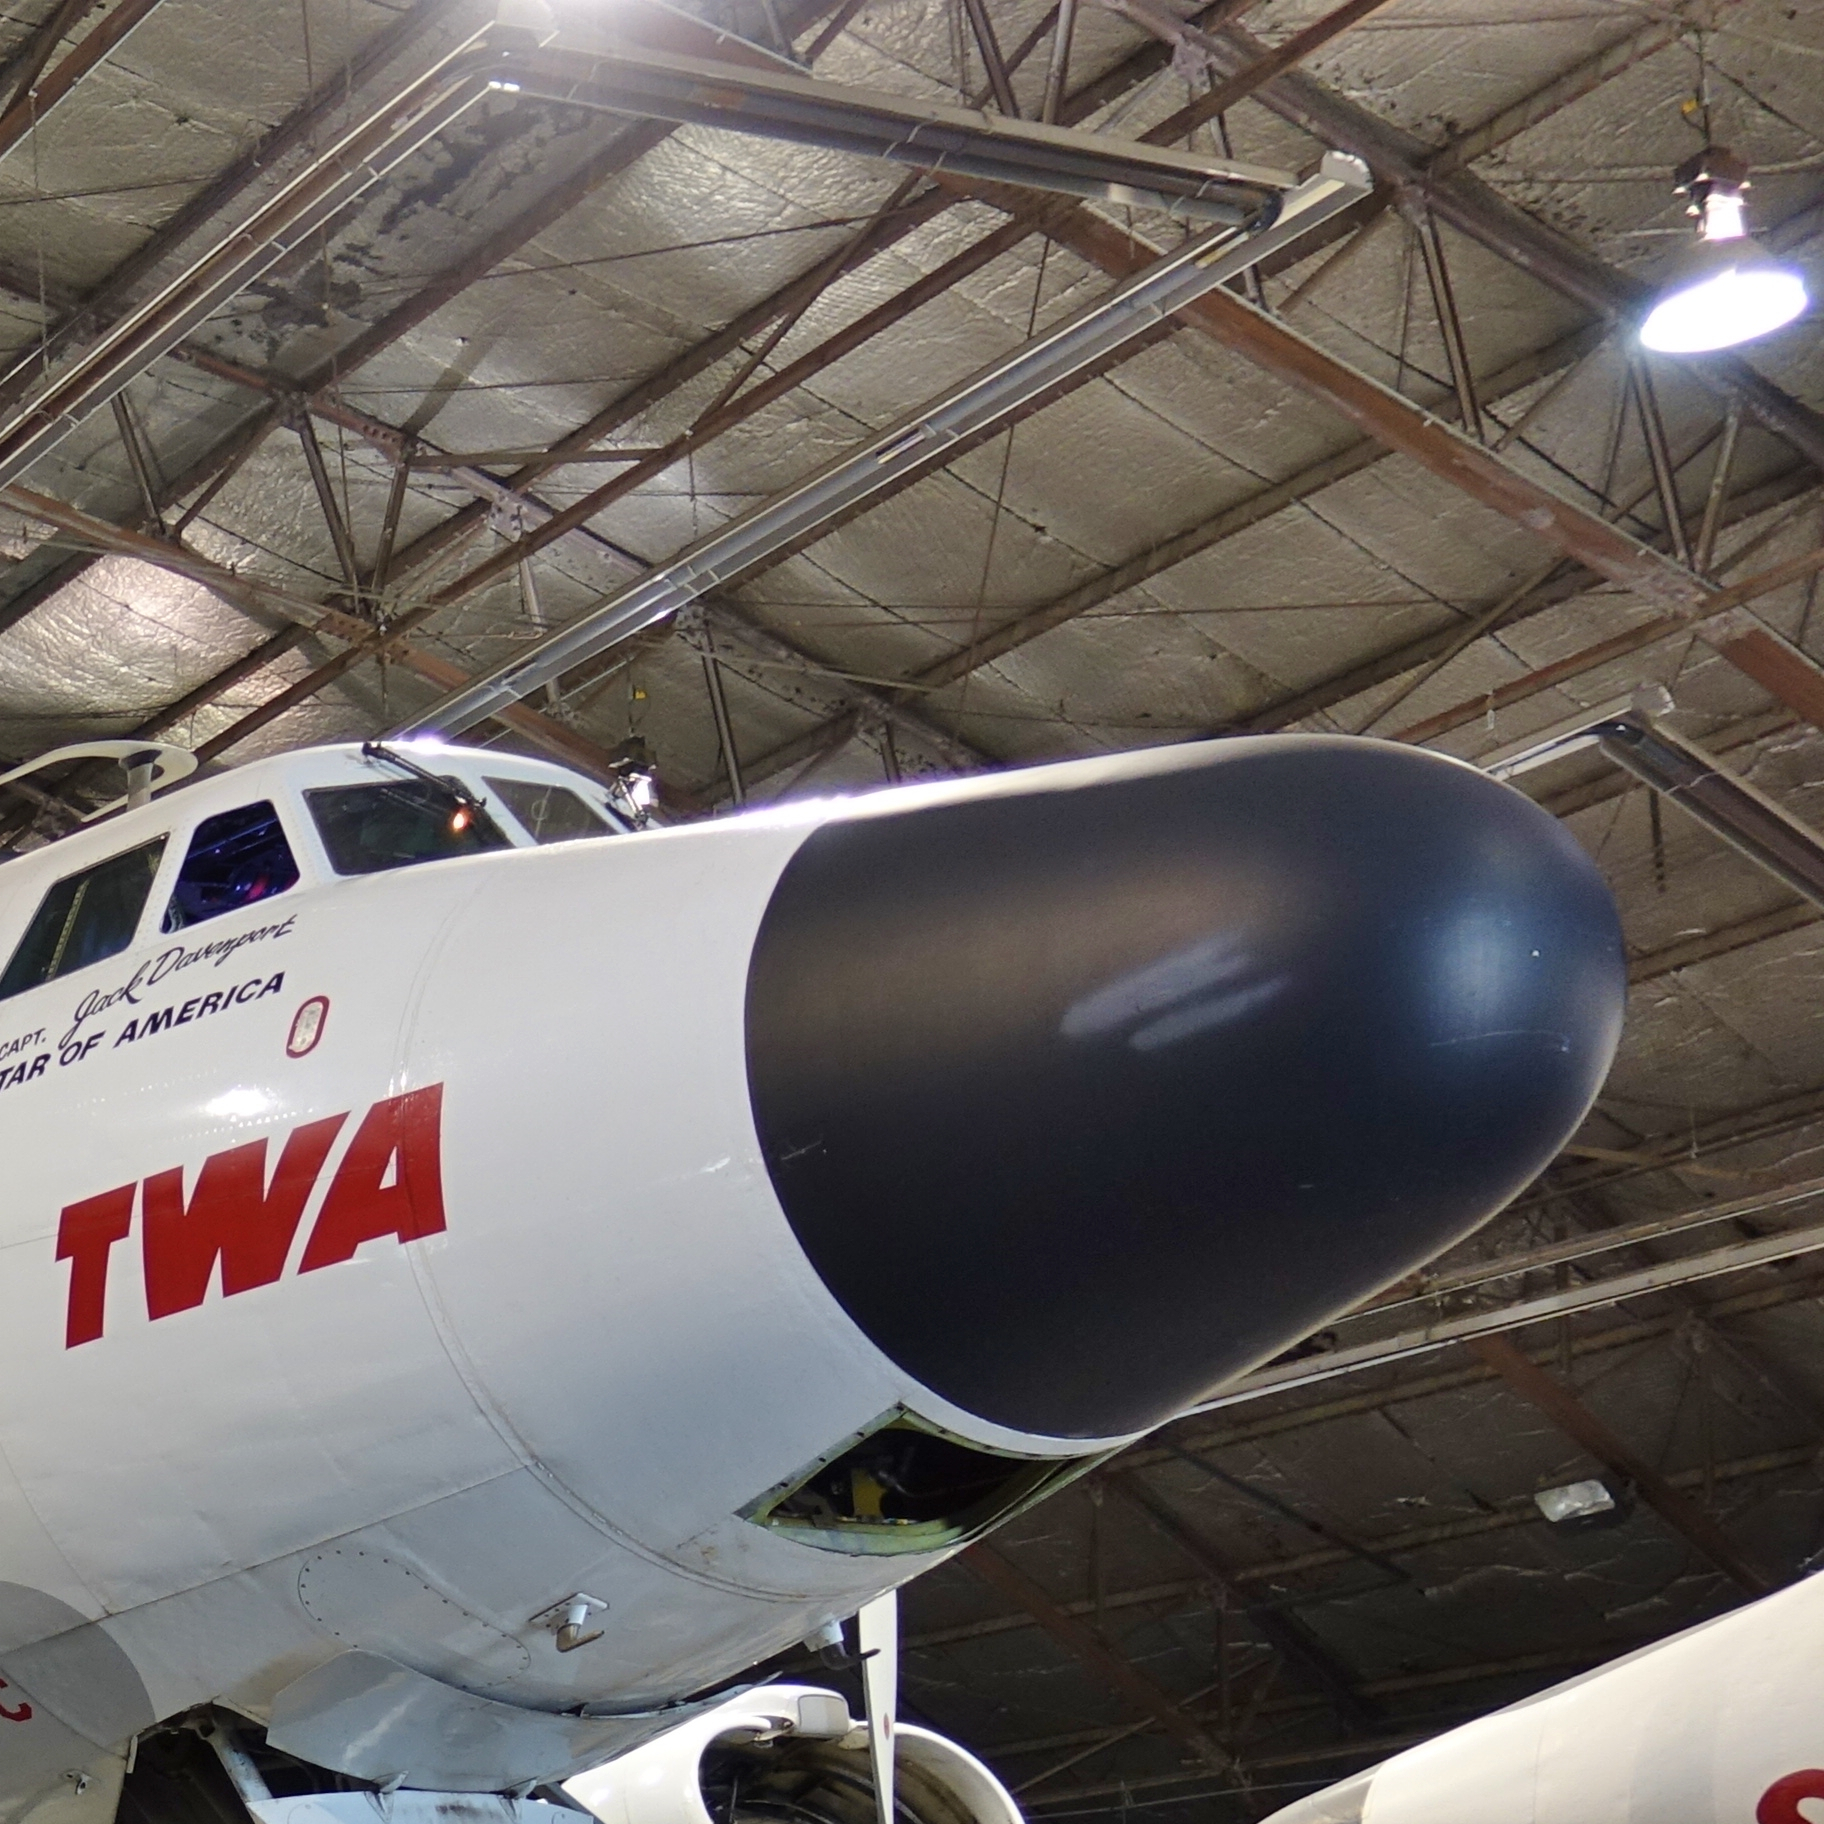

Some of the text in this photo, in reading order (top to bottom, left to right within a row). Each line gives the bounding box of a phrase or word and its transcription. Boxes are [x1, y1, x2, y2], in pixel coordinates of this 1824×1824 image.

[58, 959, 151, 1051] Jack
[146, 913, 298, 987] Davenport
[59, 1030, 107, 1067] OF
[112, 971, 286, 1049] AMERICA
[55, 1082, 447, 1350] TWA
